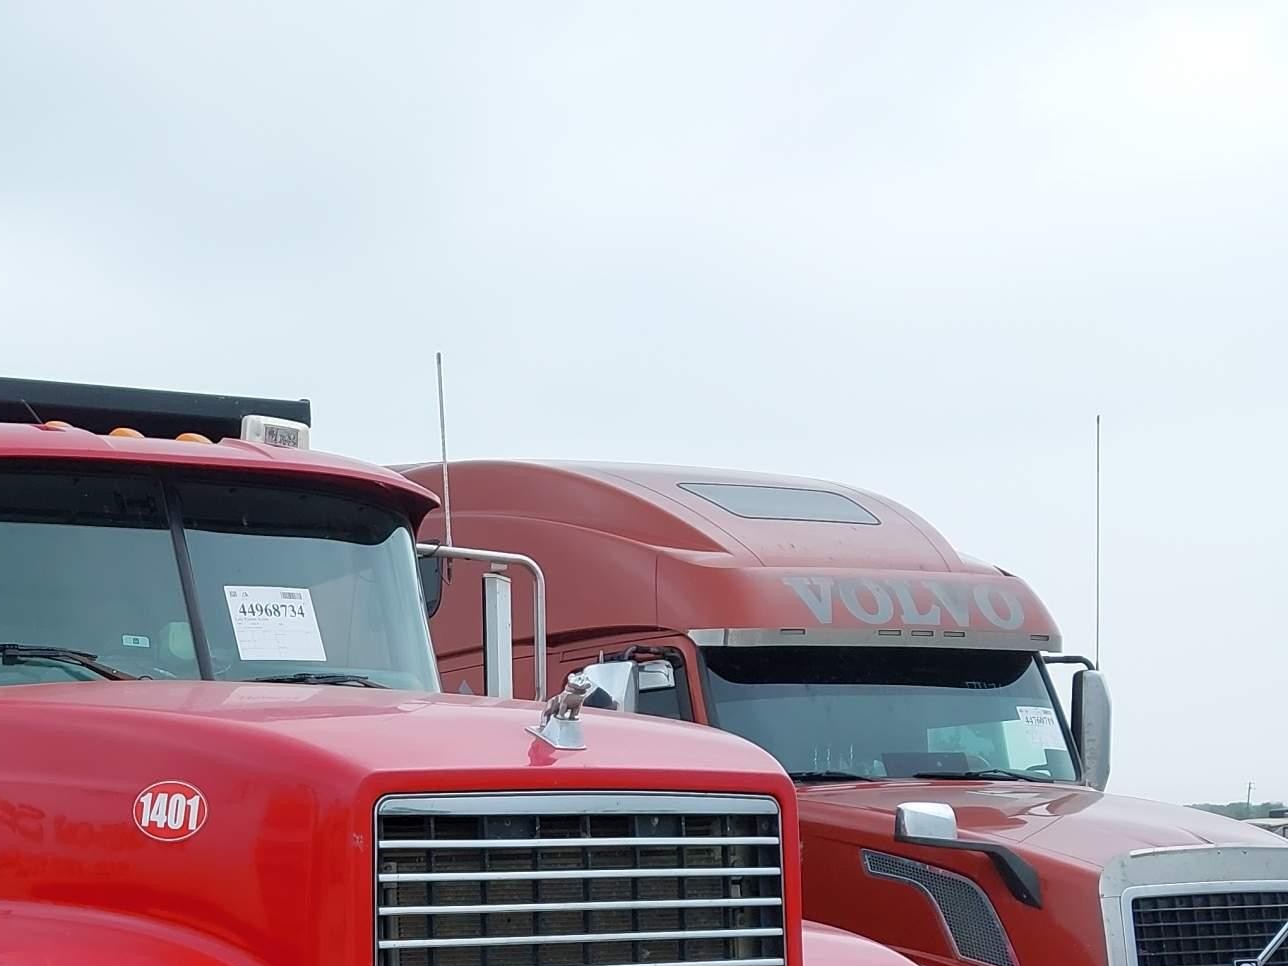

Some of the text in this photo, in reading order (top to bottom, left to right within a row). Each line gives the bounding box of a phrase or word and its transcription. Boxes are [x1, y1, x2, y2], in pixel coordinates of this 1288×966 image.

[239, 602, 305, 618] 44968734
[781, 576, 1025, 630] VOLVO
[140, 792, 200, 831] 1401
